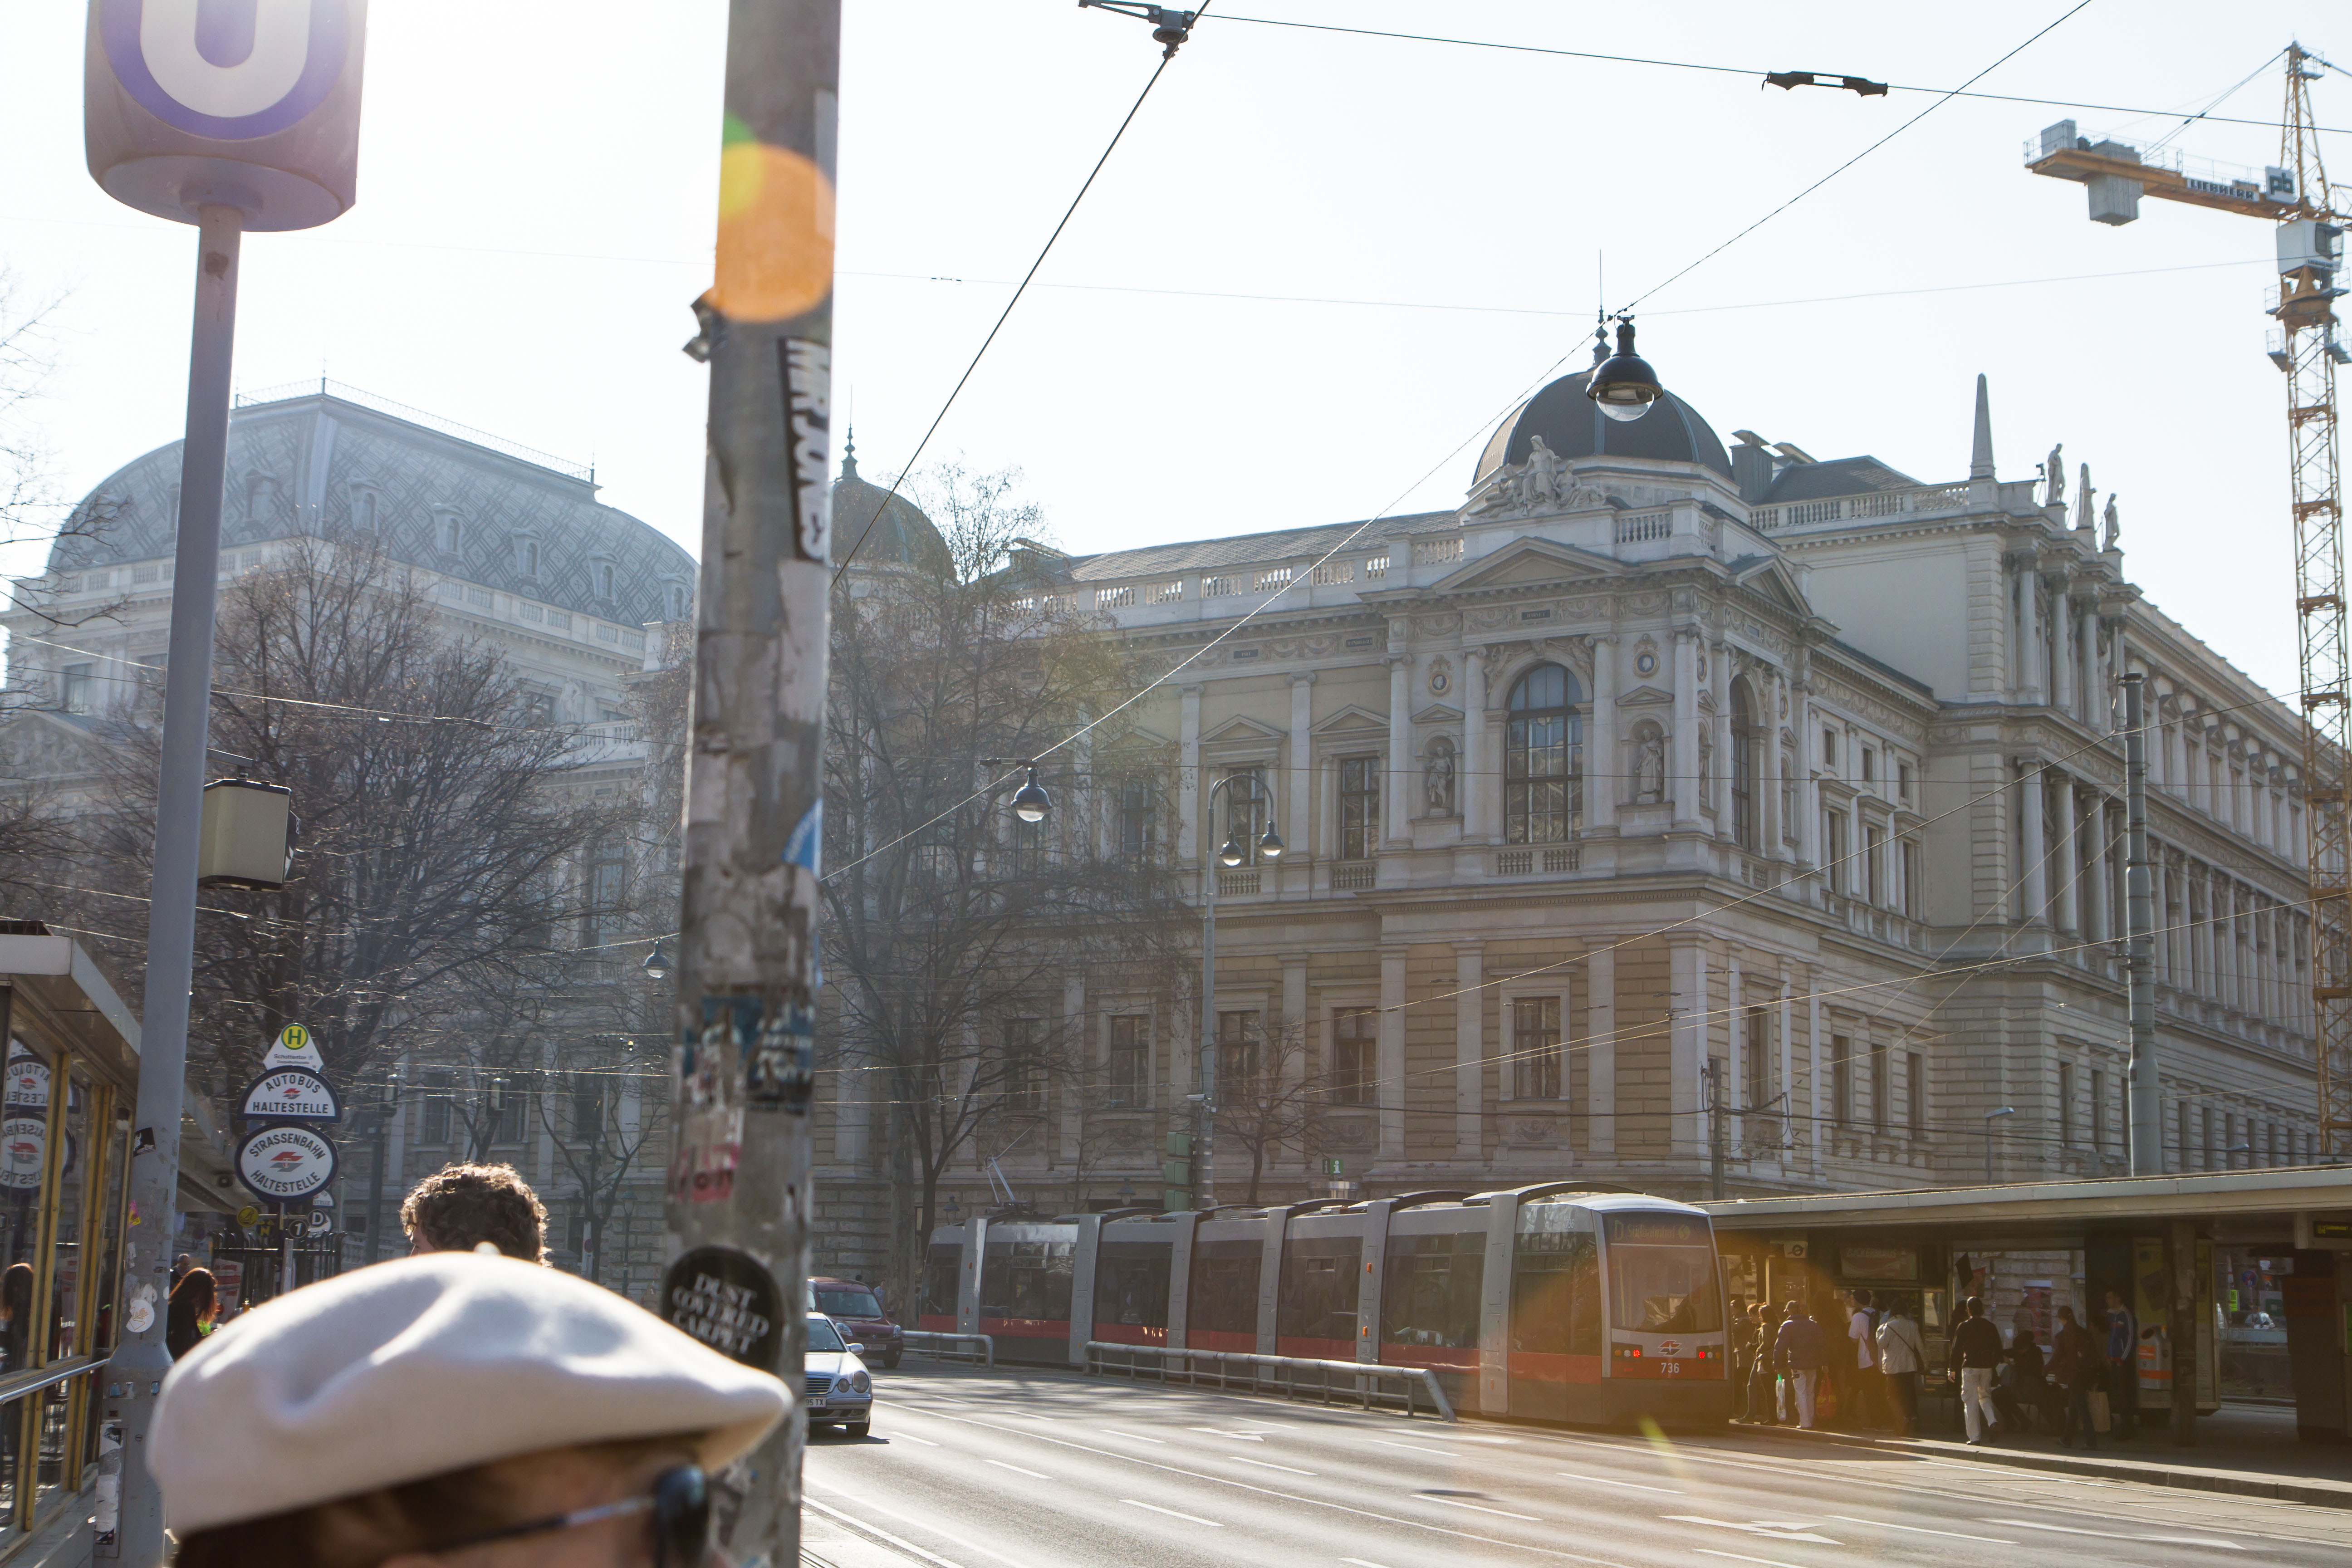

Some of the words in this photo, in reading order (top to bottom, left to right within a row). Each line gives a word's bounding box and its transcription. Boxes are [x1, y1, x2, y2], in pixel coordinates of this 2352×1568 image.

[140, 0, 311, 118] U
[2190, 178, 2254, 200] LIEBHERR
[2270, 172, 2294, 195] pb
[288, 1029, 301, 1044] H
[265, 1074, 320, 1093] AUTOBUS
[253, 1102, 328, 1113] HALTESTELLE
[250, 1133, 325, 1160] STRASSENBAHN
[250, 1170, 320, 1192] HALTESTELLE
[295, 1223, 302, 1235] 1
[312, 1212, 323, 1225] D
[260, 1226, 270, 1236] N
[694, 1273, 757, 1309] DUST
[672, 1287, 769, 1338] COVERED
[673, 1309, 757, 1354] CARPET
[1661, 1362, 1679, 1373] 736
